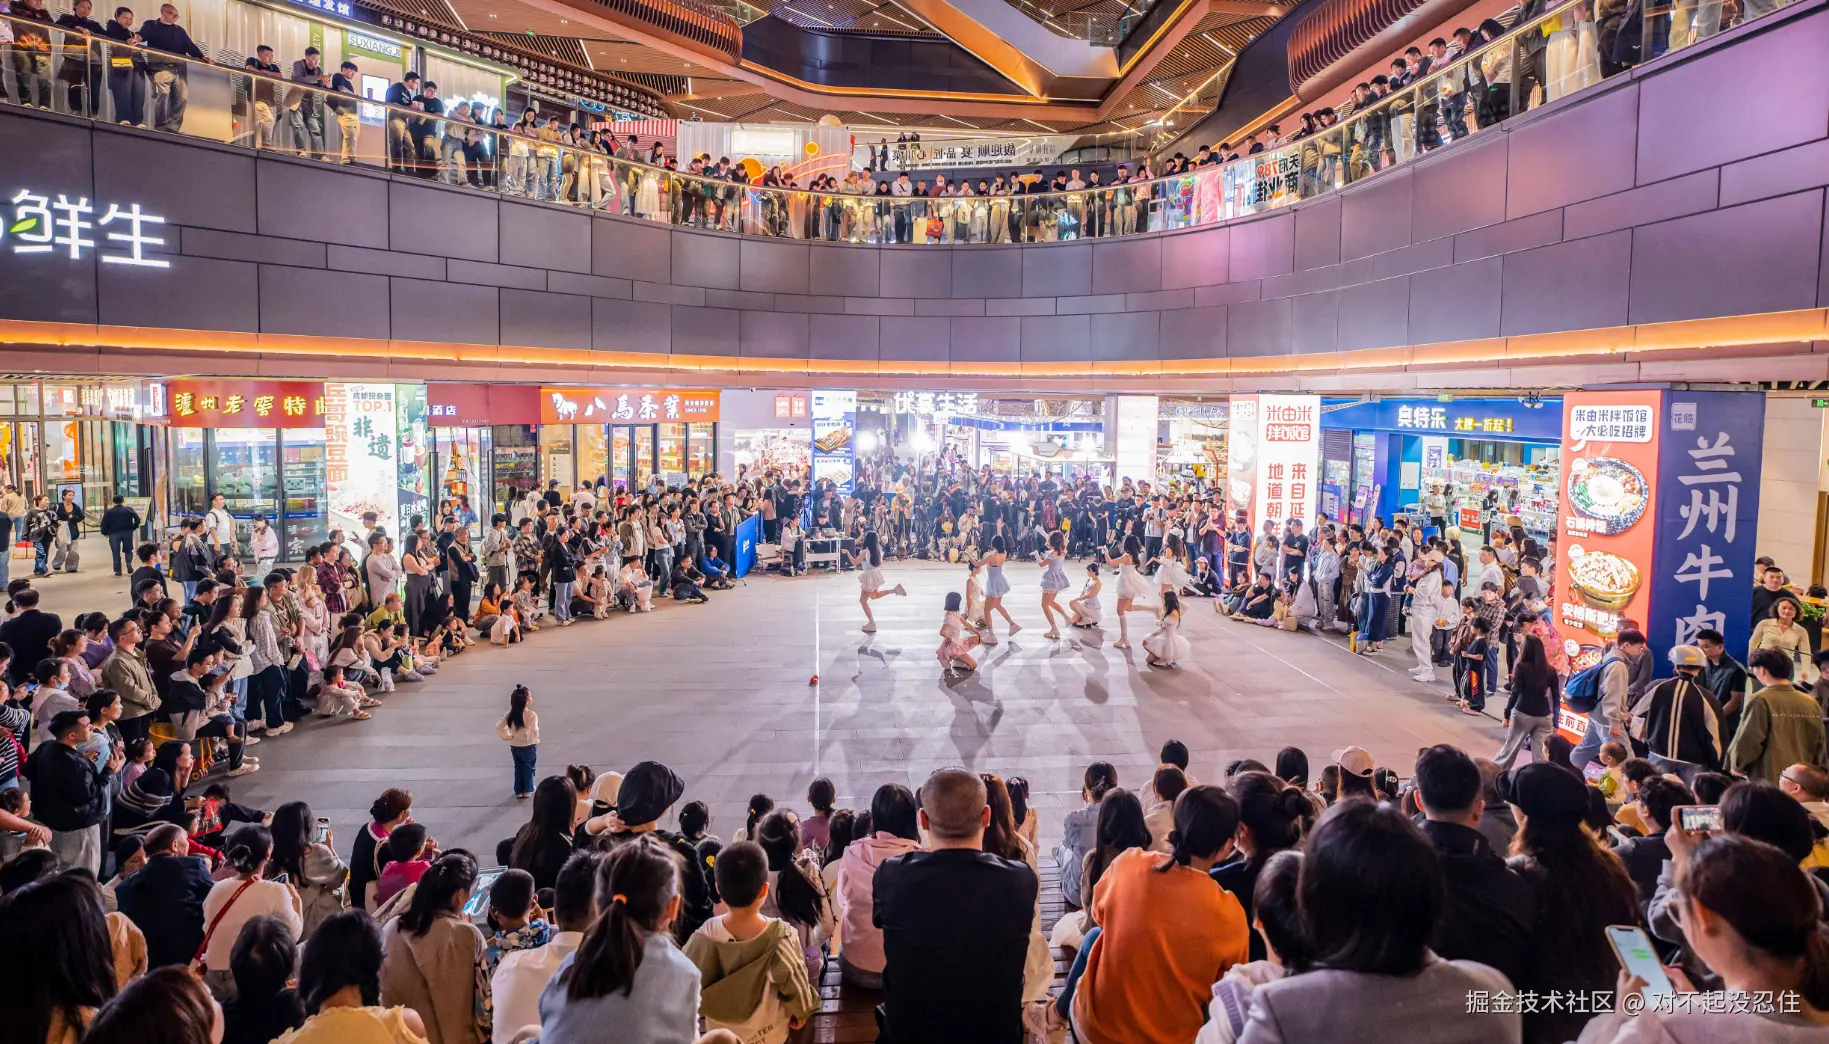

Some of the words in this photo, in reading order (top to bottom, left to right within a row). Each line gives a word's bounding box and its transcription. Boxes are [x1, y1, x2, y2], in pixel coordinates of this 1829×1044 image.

[349, 36, 392, 54] SUXIANG
[427, 405, 457, 416] 酒店
[1266, 405, 1312, 422] 米由米
[1397, 405, 1448, 429] 奥特乐
[1575, 409, 1648, 423] 米由米拌饭馆
[353, 416, 393, 461] 非遗
[1289, 463, 1307, 530] 来自延
